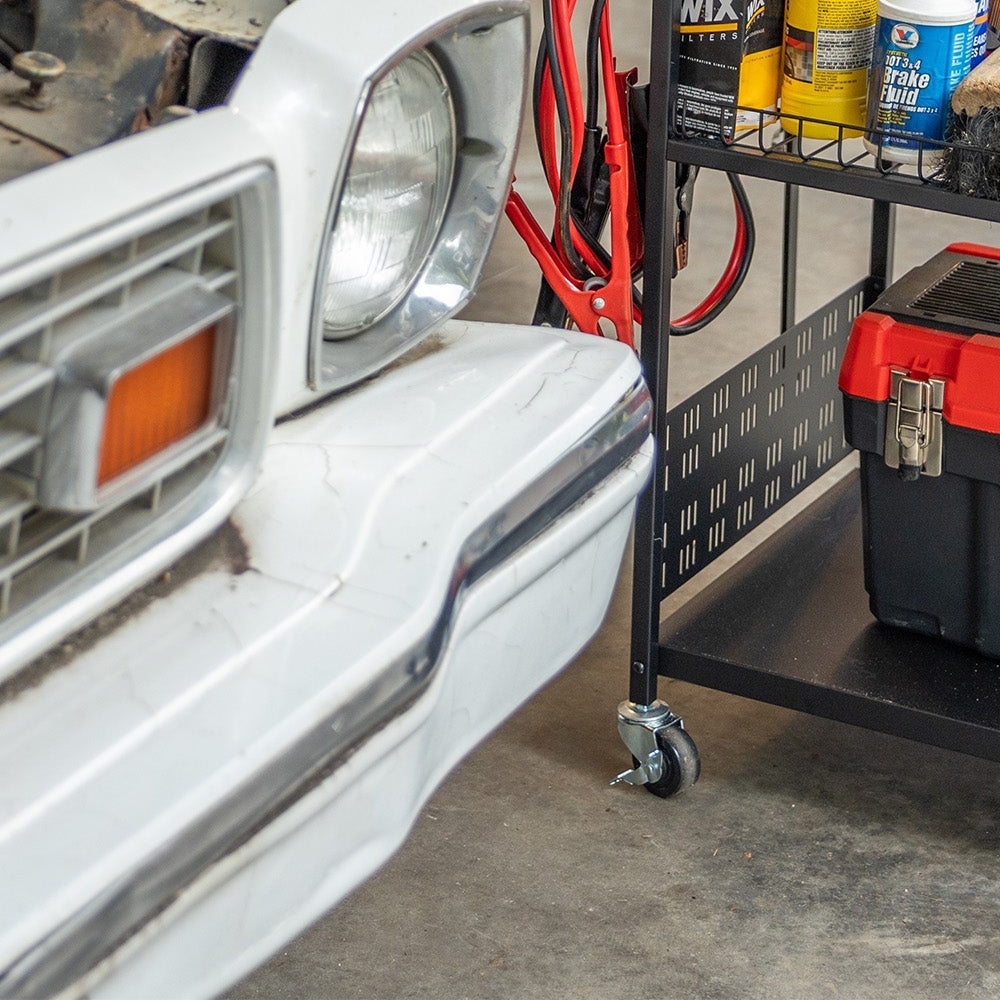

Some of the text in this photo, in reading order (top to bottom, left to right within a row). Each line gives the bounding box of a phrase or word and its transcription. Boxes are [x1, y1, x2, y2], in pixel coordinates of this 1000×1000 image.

[681, 32, 738, 42] ILTERS
[952, 32, 965, 66] FLUID
[884, 66, 931, 89] Brake
[880, 84, 920, 106] Fluid
